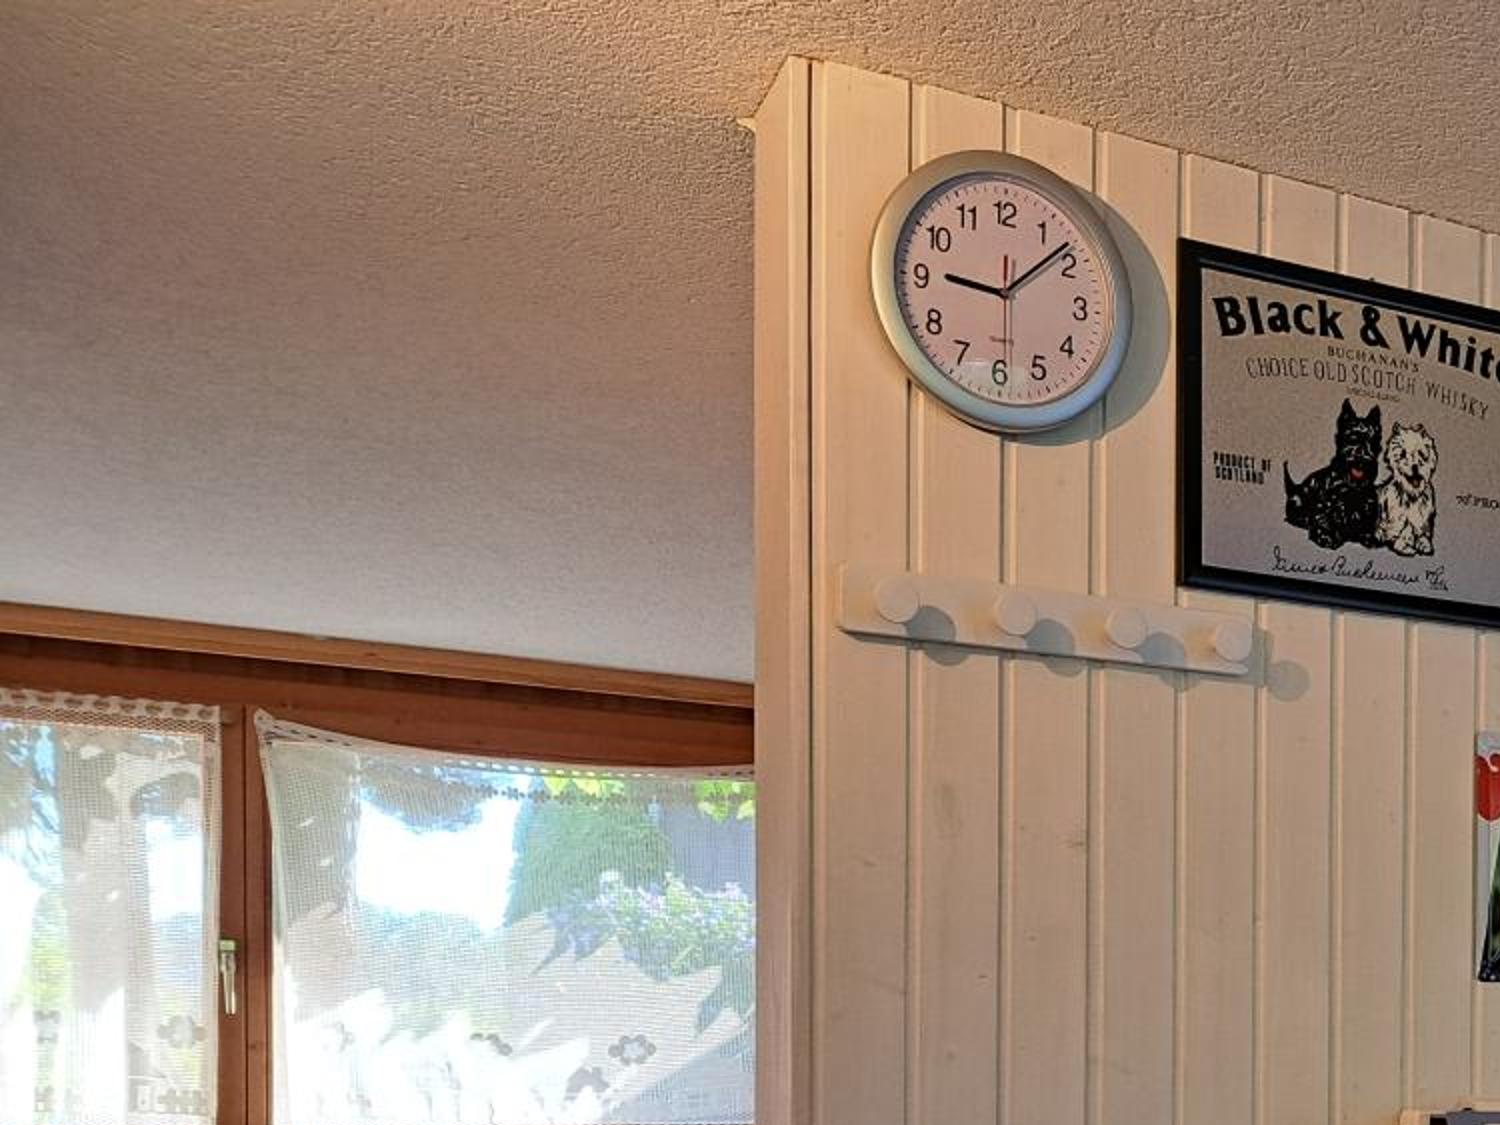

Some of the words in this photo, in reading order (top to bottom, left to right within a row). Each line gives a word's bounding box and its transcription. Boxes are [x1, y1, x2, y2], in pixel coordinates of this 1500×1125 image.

[956, 204, 977, 230] 11
[993, 201, 1017, 228] 12
[927, 226, 951, 252] 10
[1037, 222, 1046, 245] 1
[913, 263, 930, 288] 9
[1061, 253, 1077, 278] 2
[1072, 296, 1088, 321] 3
[926, 308, 942, 335] 8
[1212, 295, 1344, 341] Black
[1359, 305, 1390, 349] &
[953, 339, 970, 365] 7
[1059, 335, 1075, 358] 4
[1031, 355, 1047, 380] 5
[1327, 346, 1419, 373] BUCHANAN'S
[991, 360, 1008, 385] 6
[1245, 357, 1309, 379] CHOICE
[1313, 359, 1347, 383] OLD
[1351, 363, 1416, 395] SCOTCH
[1425, 381, 1489, 420] WHISKY
[1213, 451, 1255, 469] PRODUCT
[1215, 466, 1264, 485] SCOTLAND
